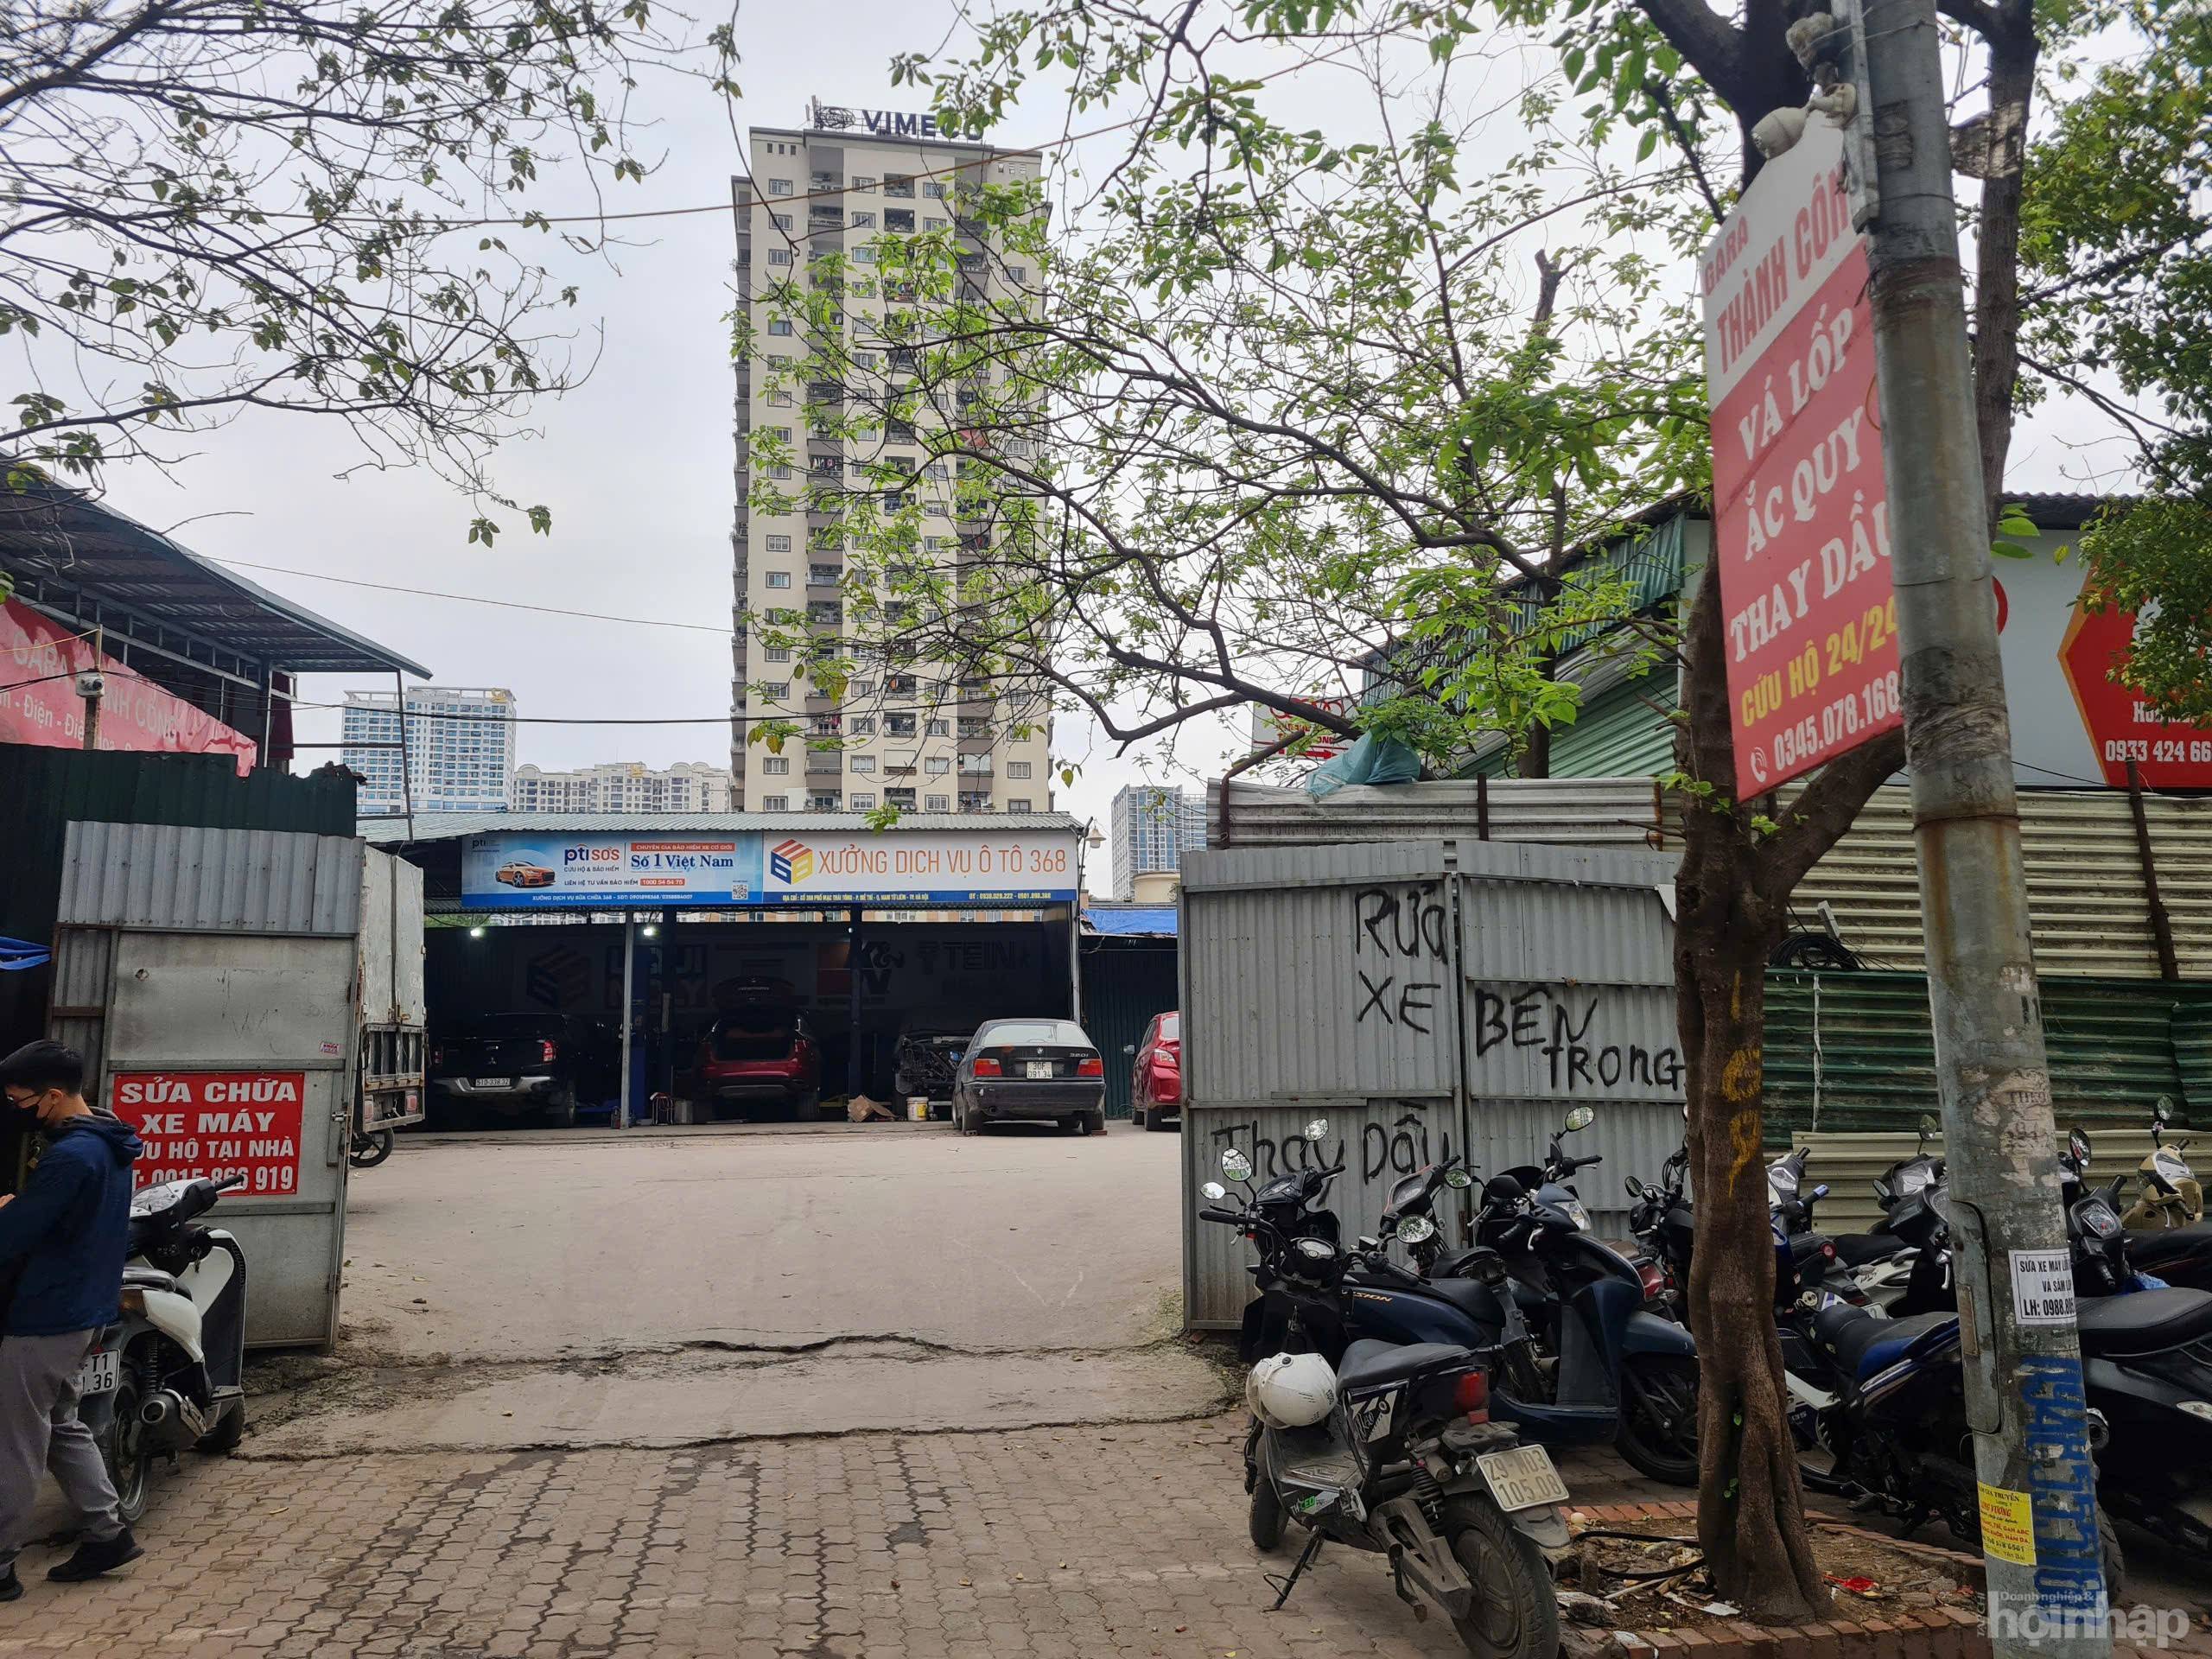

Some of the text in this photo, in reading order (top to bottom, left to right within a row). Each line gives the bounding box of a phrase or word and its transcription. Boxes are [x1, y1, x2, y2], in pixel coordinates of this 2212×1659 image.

[1705, 214, 1750, 296] GARA
[1716, 164, 1848, 374] THÀNH CÔN
[1738, 303, 1854, 461] VÁ LỐP
[1744, 404, 1865, 563] ẮC QUY
[1730, 559, 1812, 664] THAY
[1741, 671, 1783, 728] CỨU
[1789, 639, 1820, 697] HỘ
[1774, 671, 1901, 772] 0345.078.168
[2105, 741, 2148, 762] 0933
[2152, 740, 2185, 762] 424
[631, 853, 734, 870] Số 1 Việt Nam
[818, 843, 1066, 879] XƯỞNG DỊCH VỤ Ô TÔ 368
[1357, 970, 1441, 1034] XE
[1475, 985, 1598, 1056] BÊN
[120, 1077, 297, 1103] SỬA CHỮA
[140, 1108, 276, 1135] XE MÁY
[168, 1137, 200, 1163] HỘ
[207, 1140, 241, 1162] TẠI
[248, 1135, 295, 1157] NHÀ
[255, 1166, 294, 1191] 919
[2020, 1255, 2037, 1273] SỬA
[2038, 1260, 2048, 1273] XE
[2024, 1299, 2041, 1316] LH:
